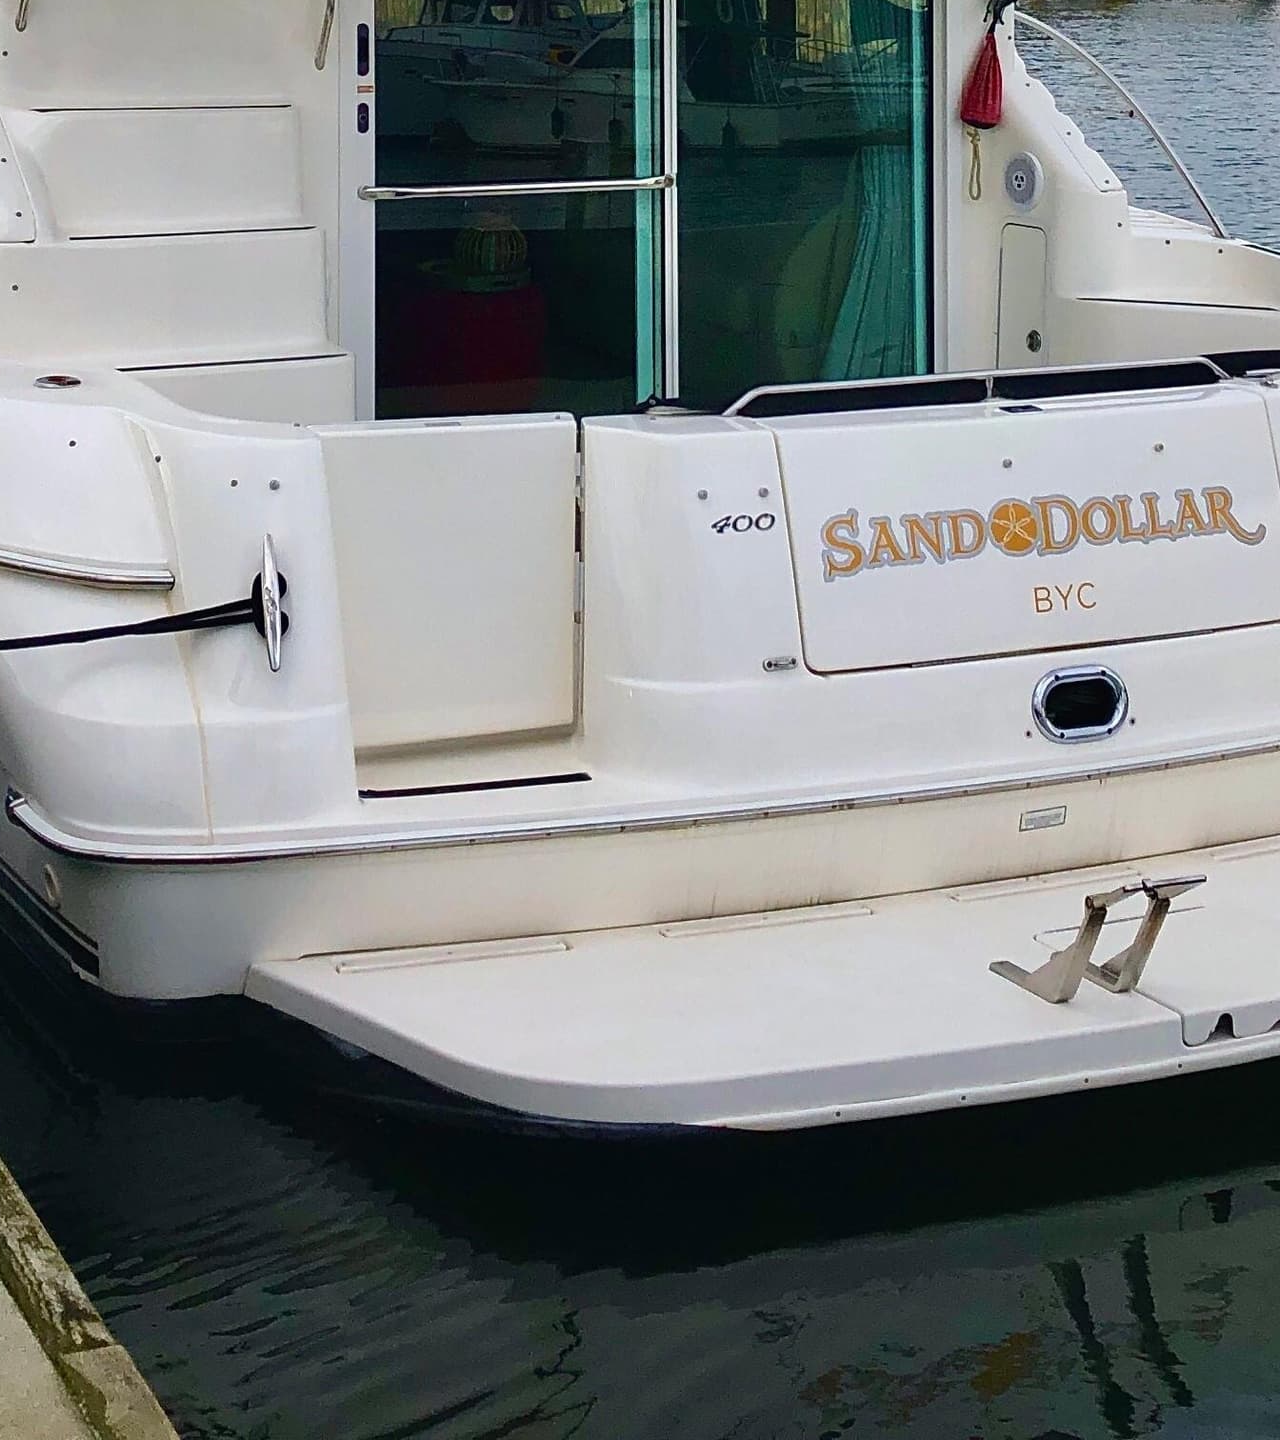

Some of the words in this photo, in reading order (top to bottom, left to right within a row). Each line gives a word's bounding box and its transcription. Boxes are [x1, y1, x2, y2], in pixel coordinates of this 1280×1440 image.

[711, 512, 775, 534] 400
[822, 509, 986, 581] SAND
[1036, 486, 1265, 555] DOLLAR
[1032, 582, 1097, 613] BYC
